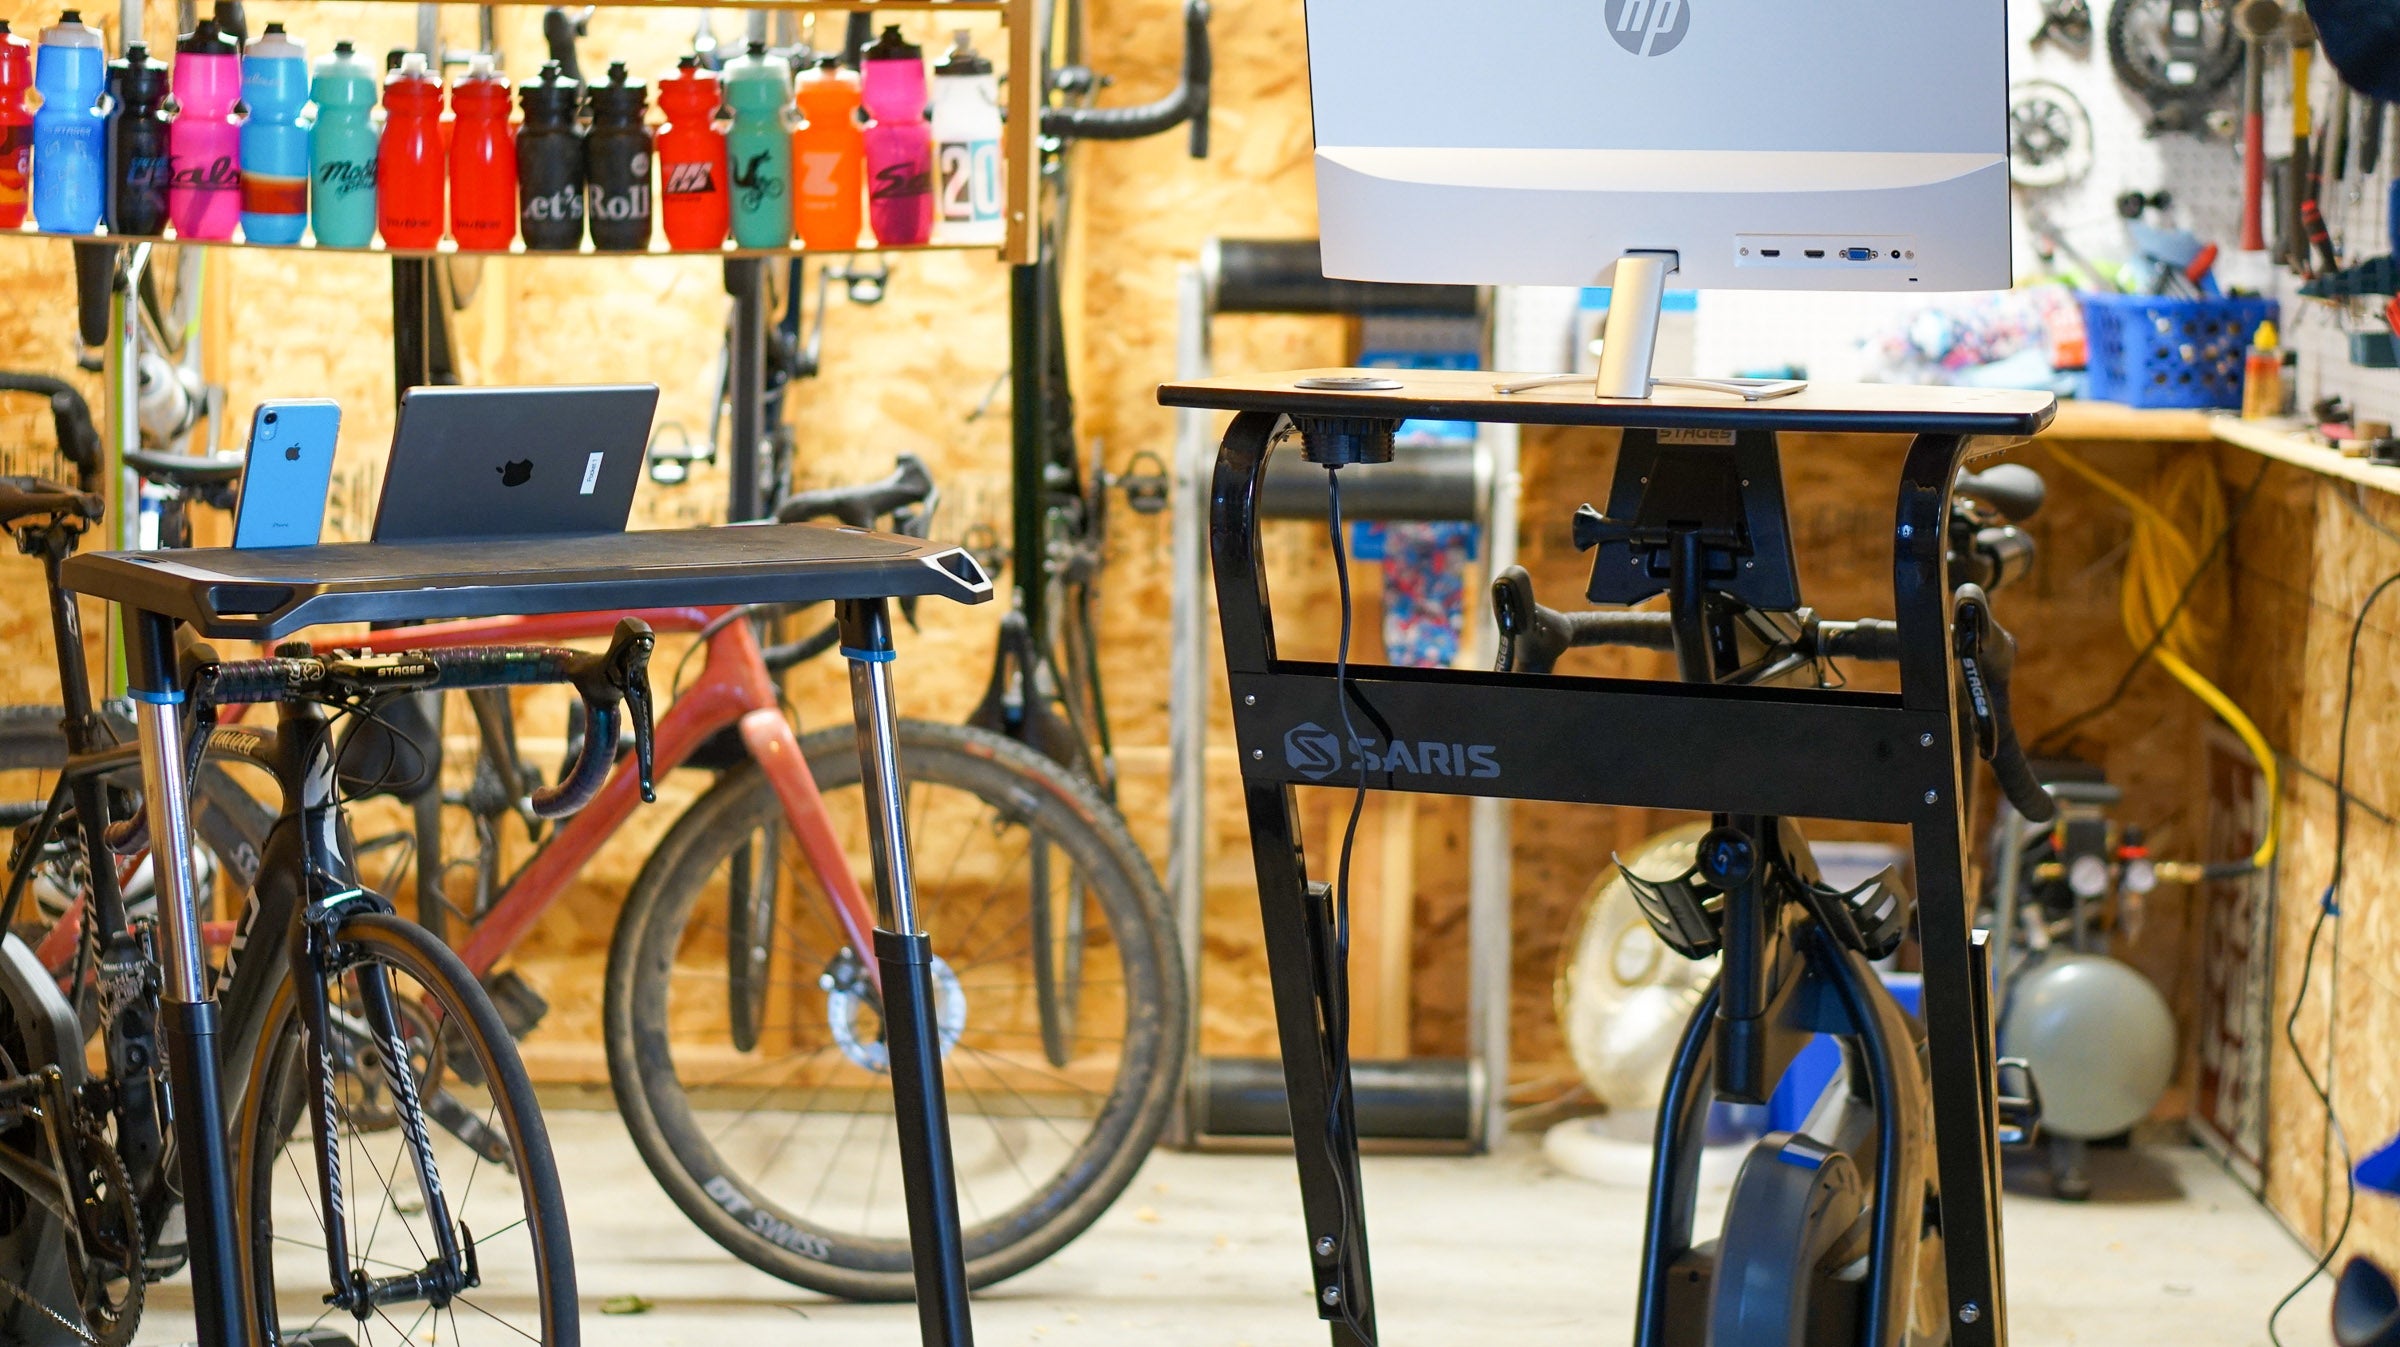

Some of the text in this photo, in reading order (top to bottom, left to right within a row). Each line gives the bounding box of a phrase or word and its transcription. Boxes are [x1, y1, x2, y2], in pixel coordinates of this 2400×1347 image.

[523, 184, 583, 221] et's
[942, 144, 1000, 219] 20
[1659, 428, 1733, 439] STAGES
[378, 665, 425, 678] STAGES
[1962, 657, 1989, 717] STAGES
[1348, 737, 1500, 778] SARIS
[320, 1044, 344, 1217] SPECIALIZED
[703, 1175, 833, 1260] DT SWISS
